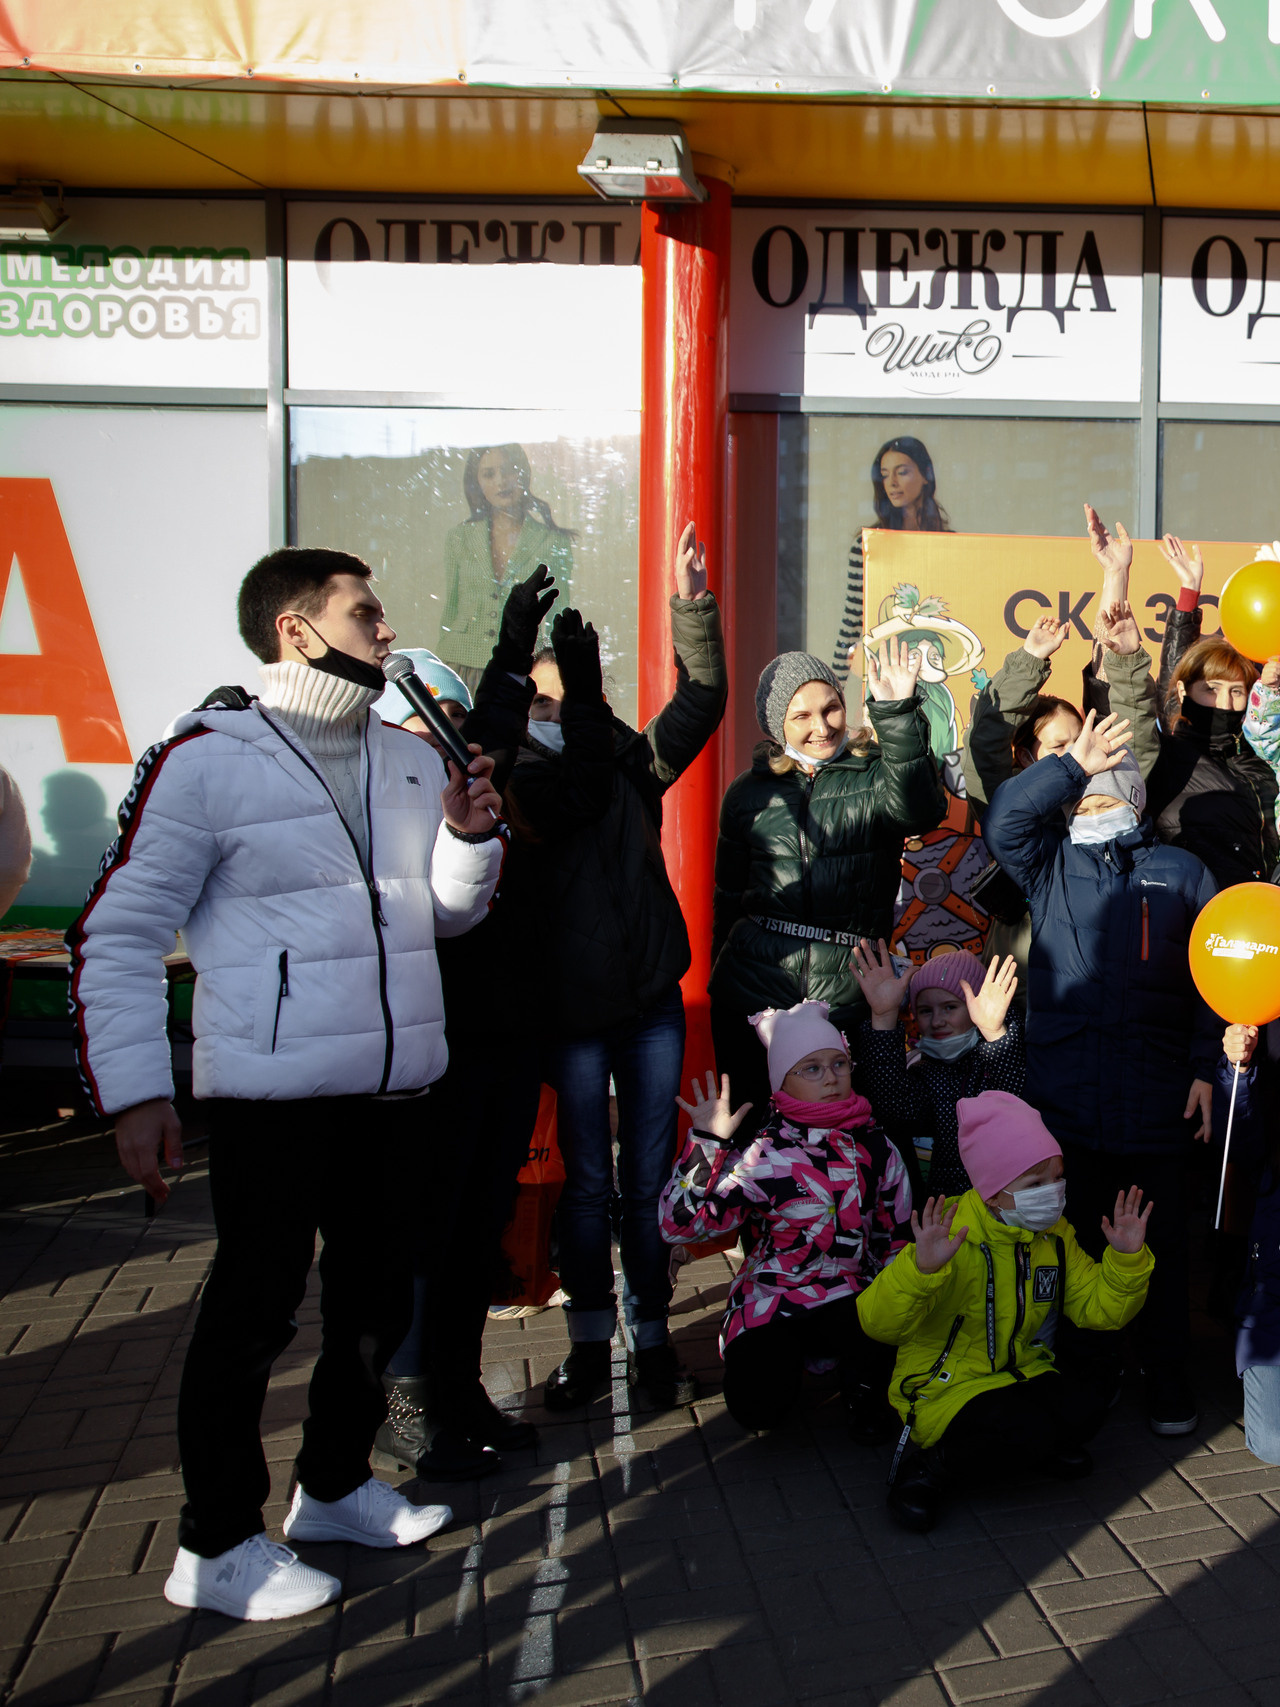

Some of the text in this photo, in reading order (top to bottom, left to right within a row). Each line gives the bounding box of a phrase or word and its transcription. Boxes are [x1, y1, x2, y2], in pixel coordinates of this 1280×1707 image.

[3, 247, 250, 288] МЕЛОДИЯ
[313, 216, 641, 296] ОДЕЖД
[751, 225, 1117, 334] ОДЕЖДА
[0, 296, 259, 337] ЗДОРОВЬЯ
[765, 917, 832, 942] TSTHEODUC
